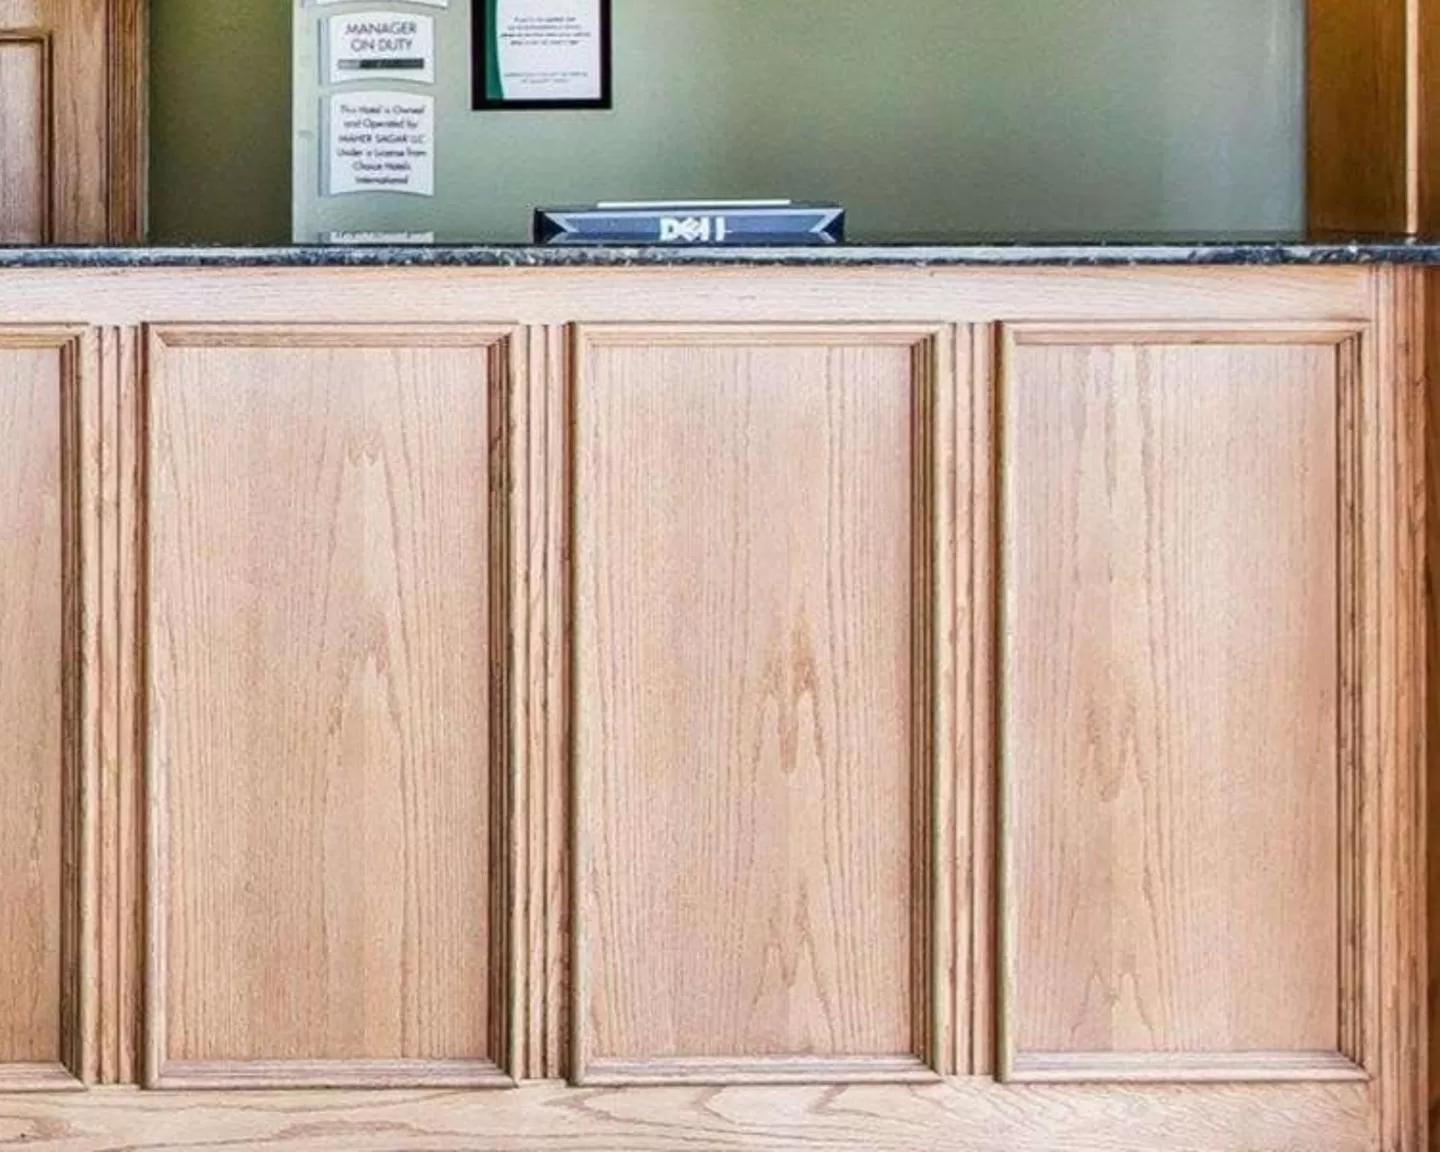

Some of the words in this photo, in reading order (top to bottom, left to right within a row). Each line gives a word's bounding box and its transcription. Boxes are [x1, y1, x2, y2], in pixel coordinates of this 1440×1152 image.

[344, 21, 418, 35] MANAGER
[350, 38, 375, 52] ON
[378, 37, 413, 51] DUTY
